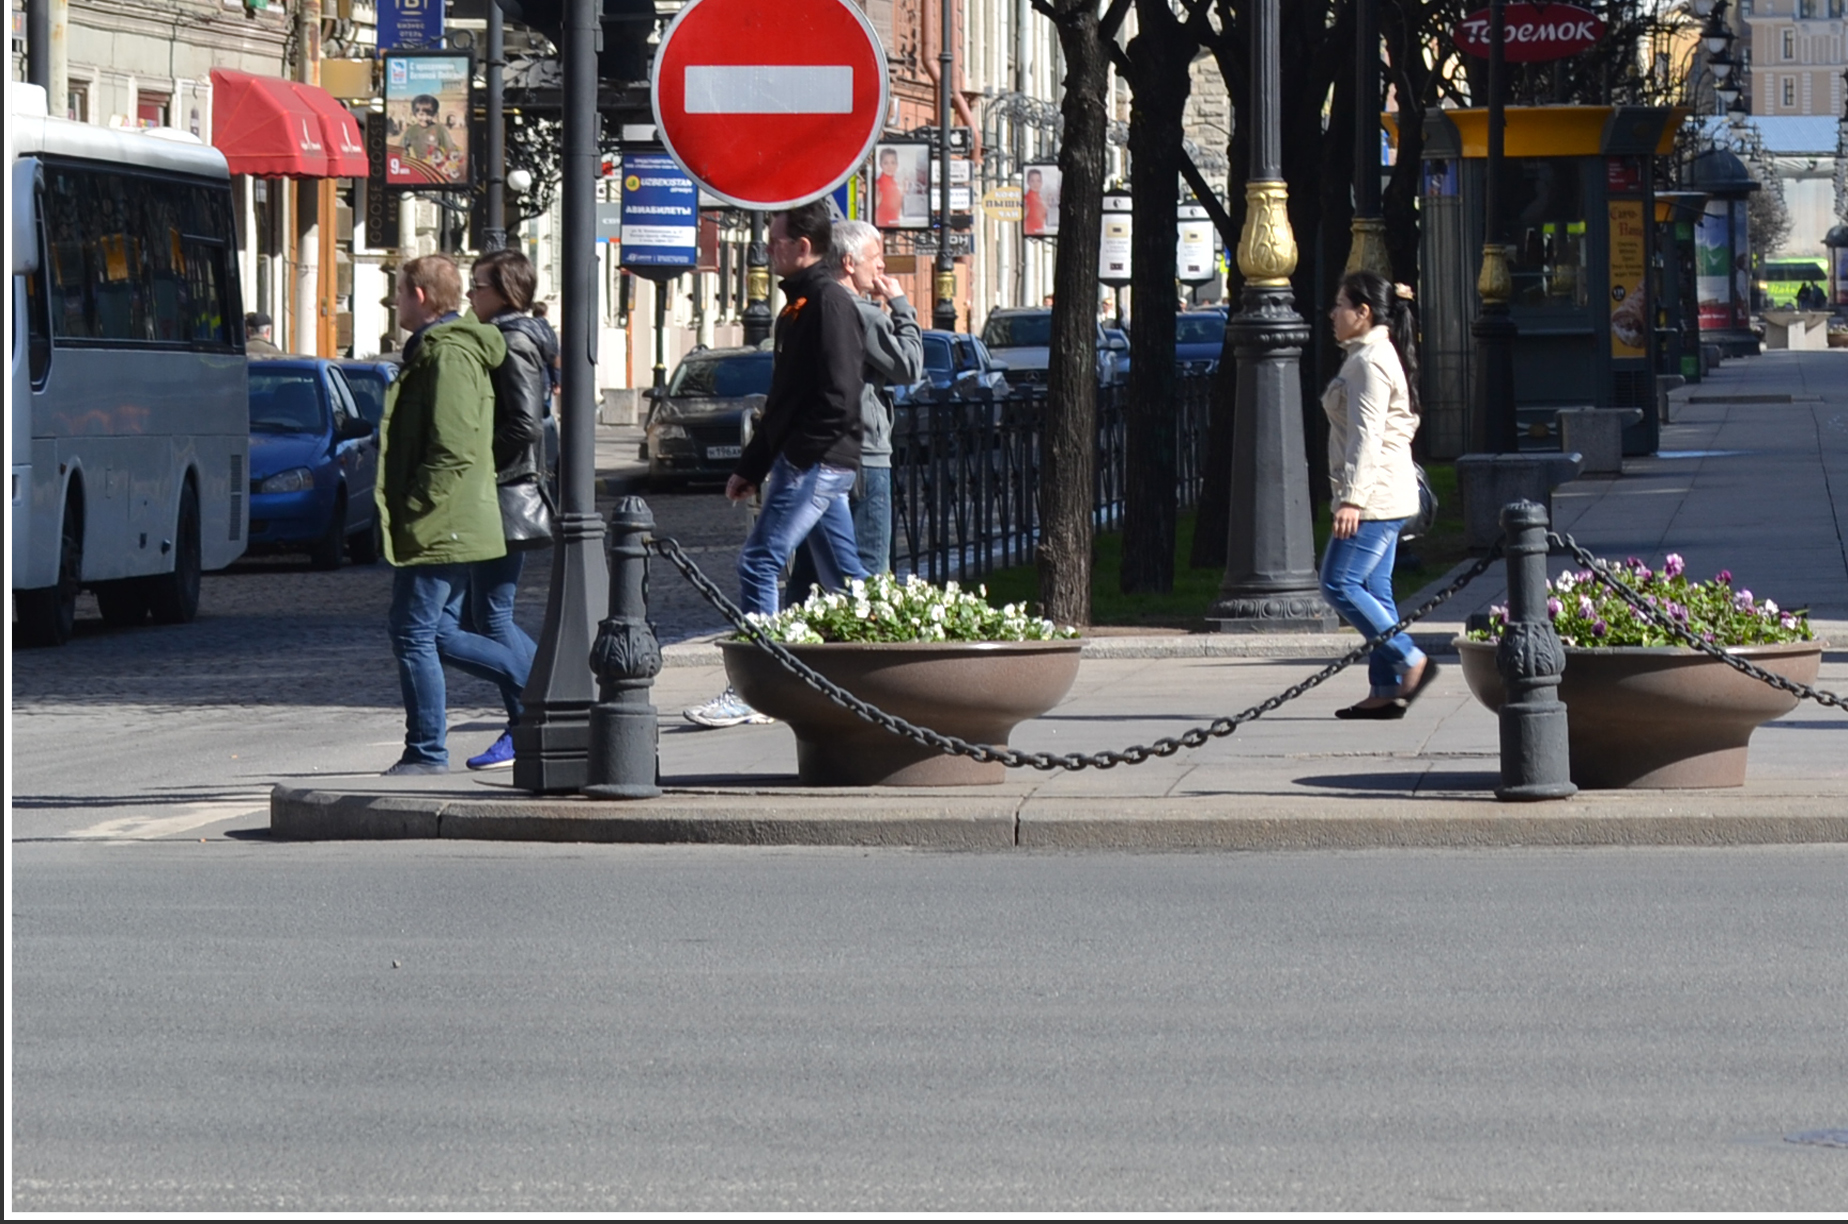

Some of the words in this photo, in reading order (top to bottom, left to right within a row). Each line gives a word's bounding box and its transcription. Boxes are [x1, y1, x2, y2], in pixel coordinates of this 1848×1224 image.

[390, 158, 400, 175] 9
[985, 200, 1023, 208] ПЫШК
[625, 205, 692, 215] АВИАБИЛЕТЫ
